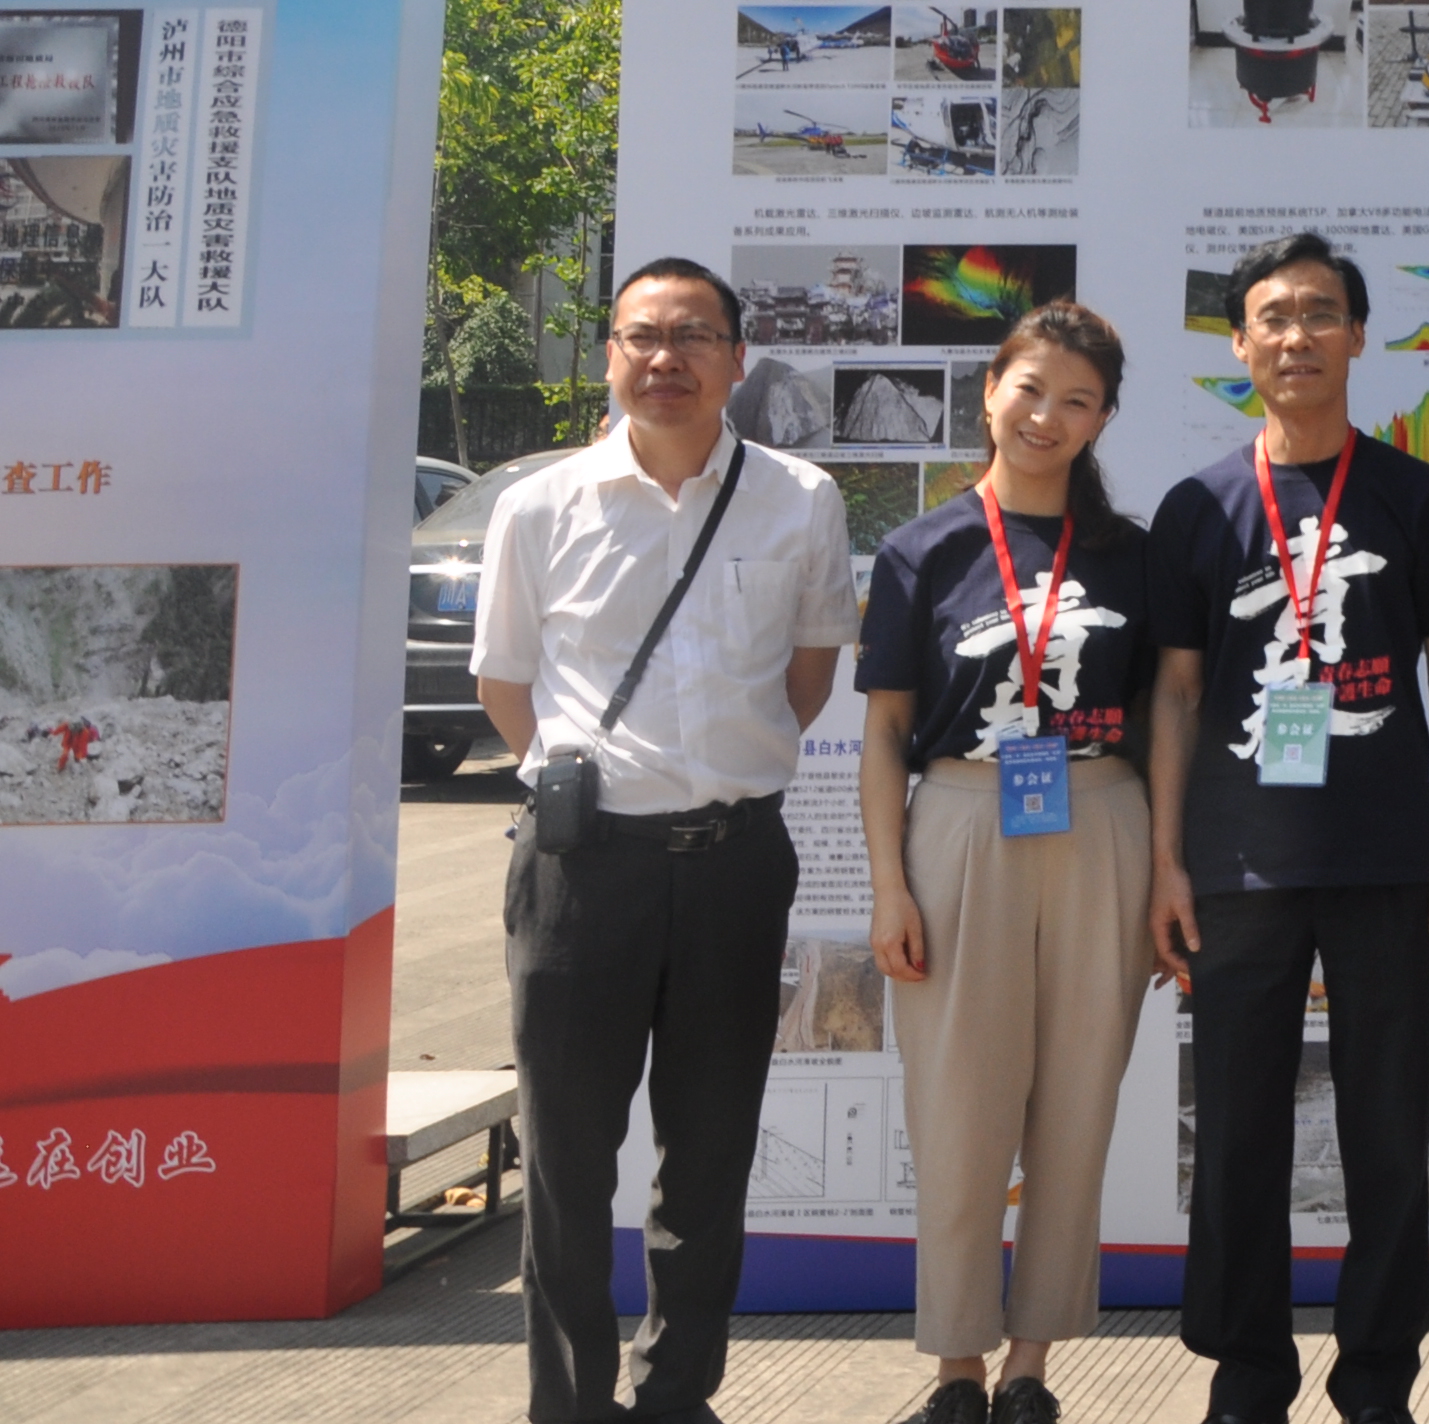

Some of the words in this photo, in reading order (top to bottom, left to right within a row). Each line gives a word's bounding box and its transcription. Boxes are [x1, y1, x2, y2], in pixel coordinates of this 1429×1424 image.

[139, 19, 188, 308] 泸州市地质灾害防治一大队
[198, 19, 248, 311] 德阳市综合应急救援支队地质灾害救援大队
[2, 460, 112, 495] 查工作
